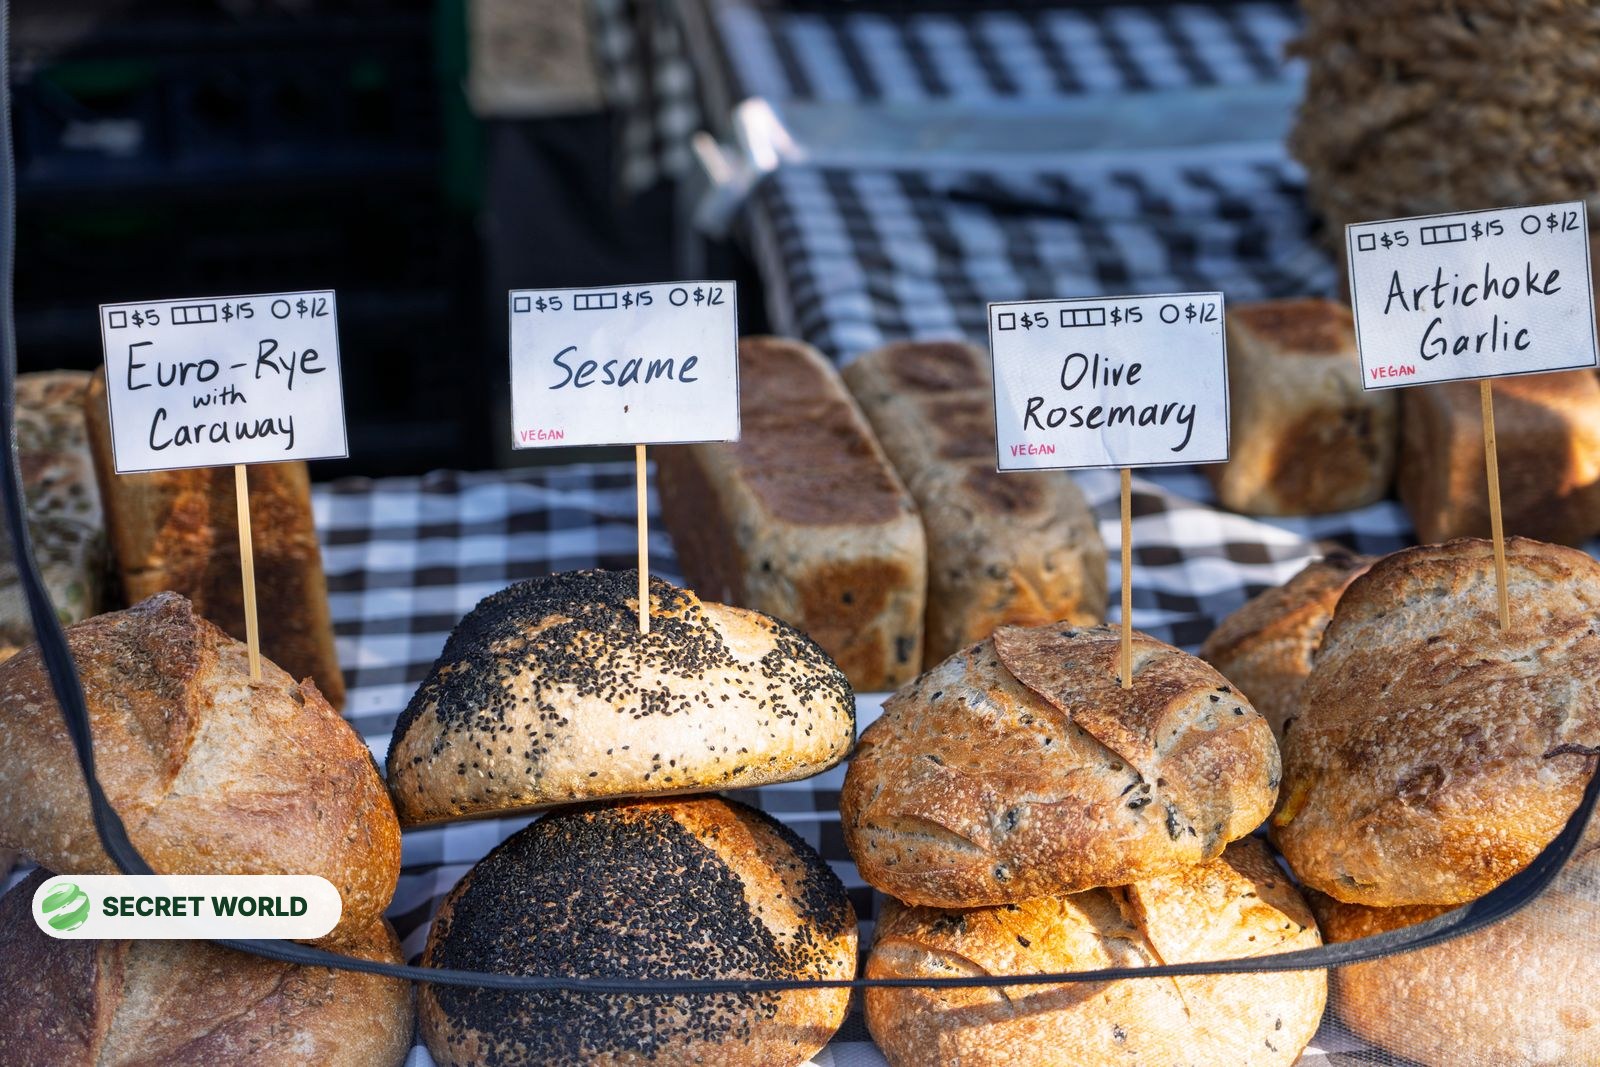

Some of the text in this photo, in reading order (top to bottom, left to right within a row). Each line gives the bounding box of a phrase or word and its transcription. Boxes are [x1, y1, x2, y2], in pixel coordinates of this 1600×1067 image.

[1380, 211, 1580, 250] $5 $15 $12
[535, 286, 725, 312] $5 $15 $12
[1383, 261, 1562, 315] Artichoke
[131, 297, 329, 328] $5 $15 $12
[1020, 302, 1218, 331] $5 $15 $12
[1420, 314, 1531, 361] Garlic
[548, 345, 699, 390] Sesame
[1060, 352, 1142, 391] Olive
[1370, 365, 1416, 380] VEGAN
[193, 384, 247, 409] with
[149, 407, 295, 451] Caraway
[520, 429, 565, 442] VEGAN
[1023, 396, 1196, 452] Rosemary
[1010, 443, 1056, 457] VEGAN
